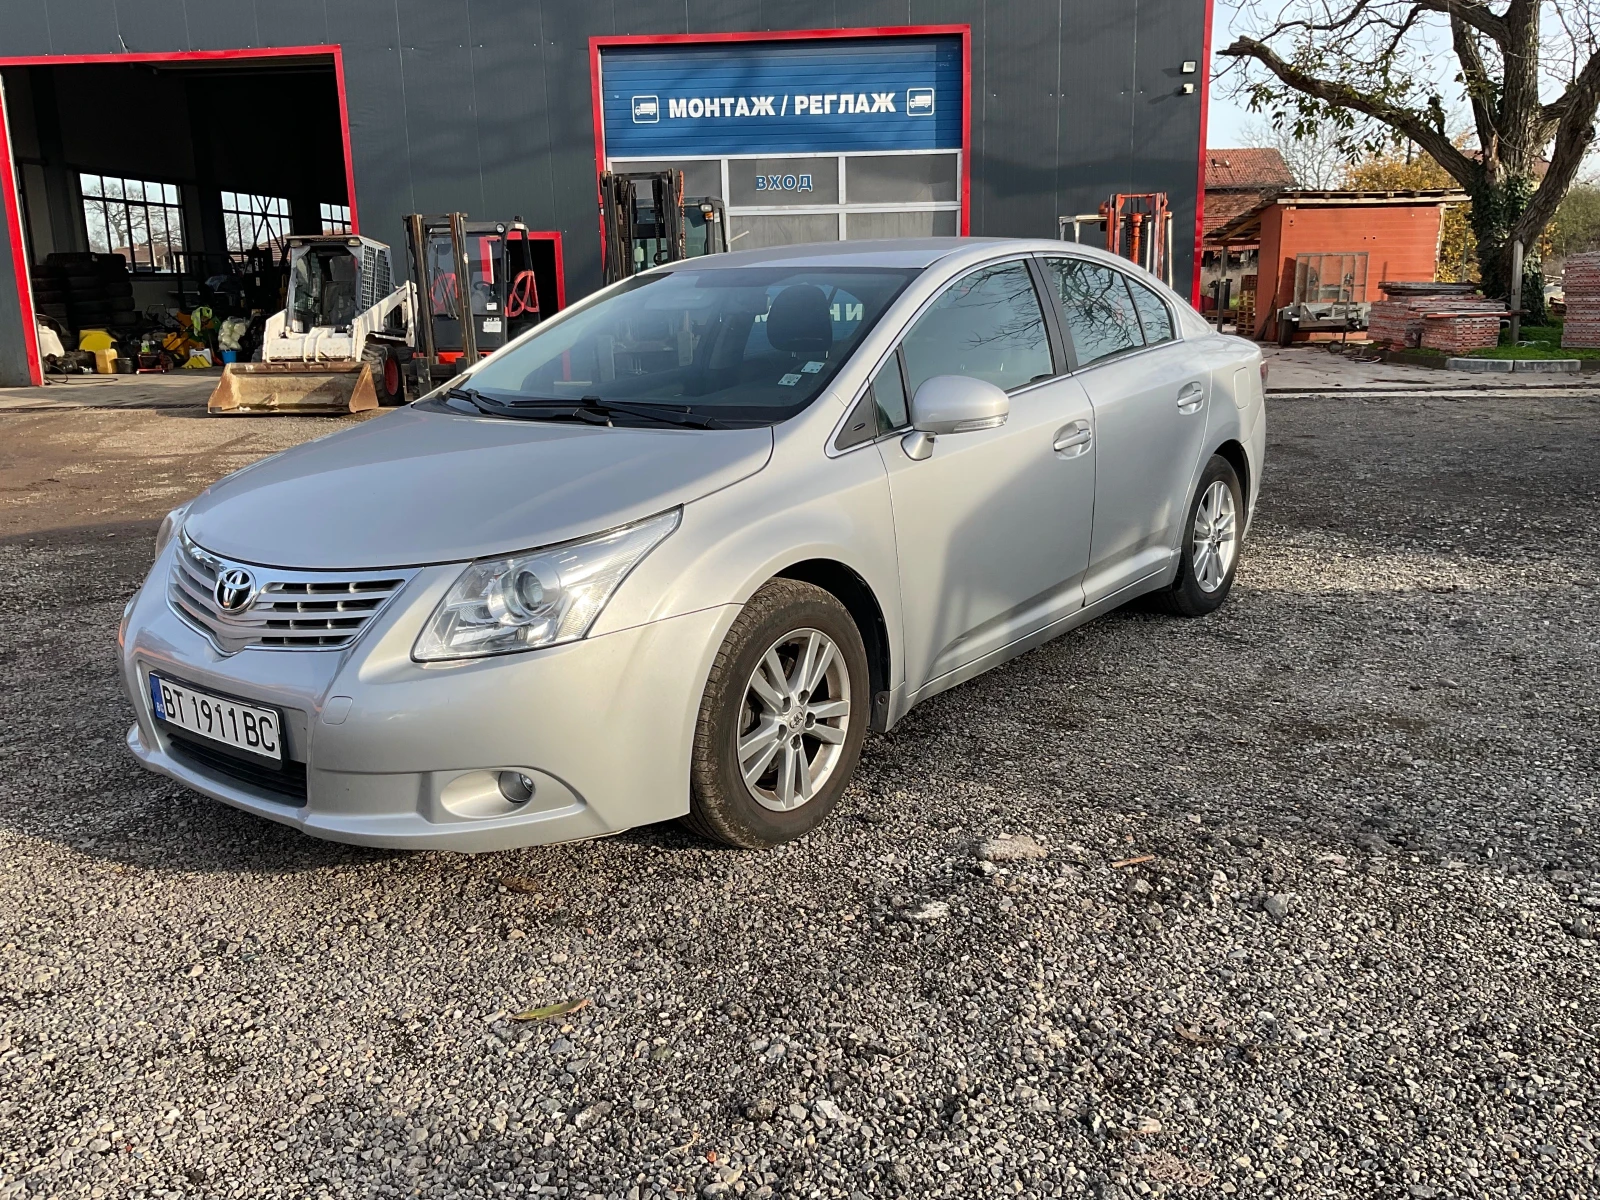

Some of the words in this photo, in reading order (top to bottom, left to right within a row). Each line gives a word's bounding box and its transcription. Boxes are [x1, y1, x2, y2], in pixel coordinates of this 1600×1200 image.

[669, 95, 776, 118] МОНТАЖ
[780, 95, 788, 116] /
[795, 93, 896, 115] РЕГЛАЖ
[756, 174, 813, 192] ВХОД
[191, 696, 240, 742] 1911
